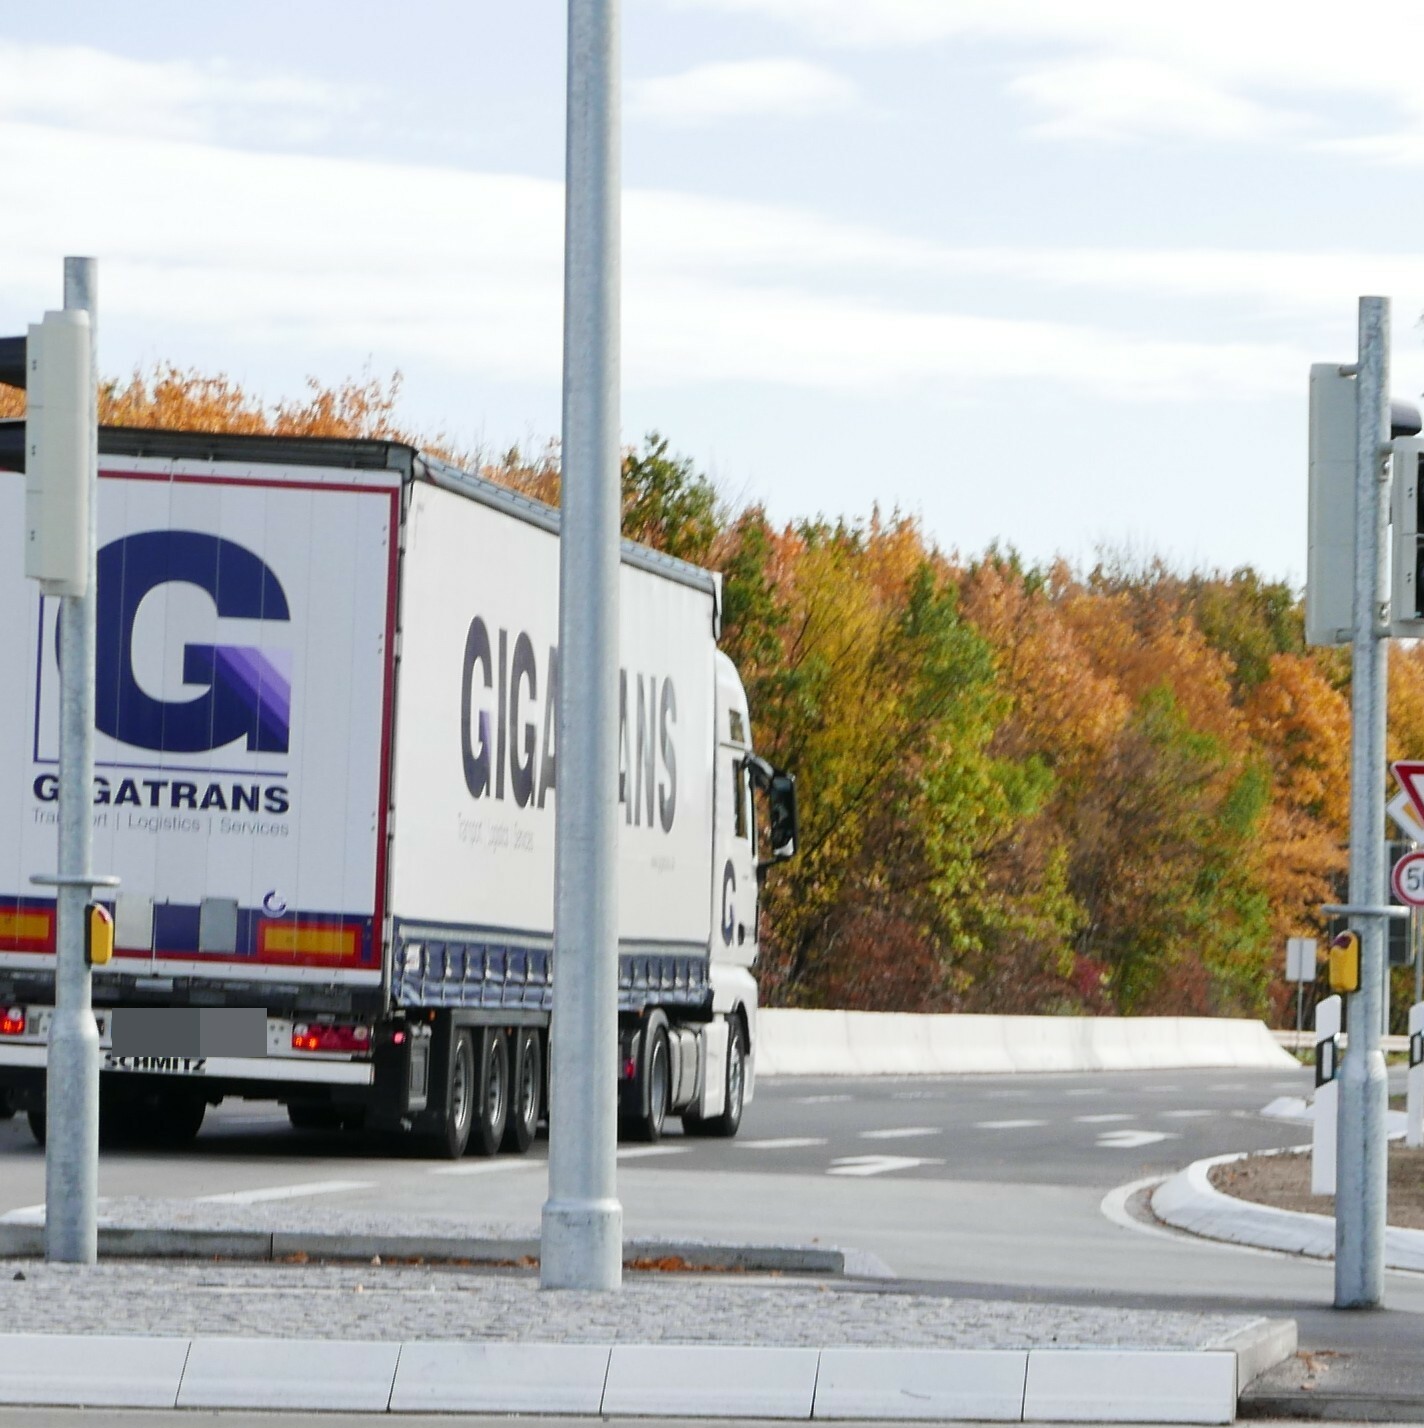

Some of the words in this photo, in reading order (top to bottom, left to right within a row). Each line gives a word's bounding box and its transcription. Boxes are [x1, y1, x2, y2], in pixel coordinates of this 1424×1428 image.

[56, 529, 291, 753] G
[461, 615, 678, 834] GIGAANS
[33, 774, 290, 814] GGATRANS
[128, 813, 201, 834] Logistics
[220, 816, 289, 838] Services
